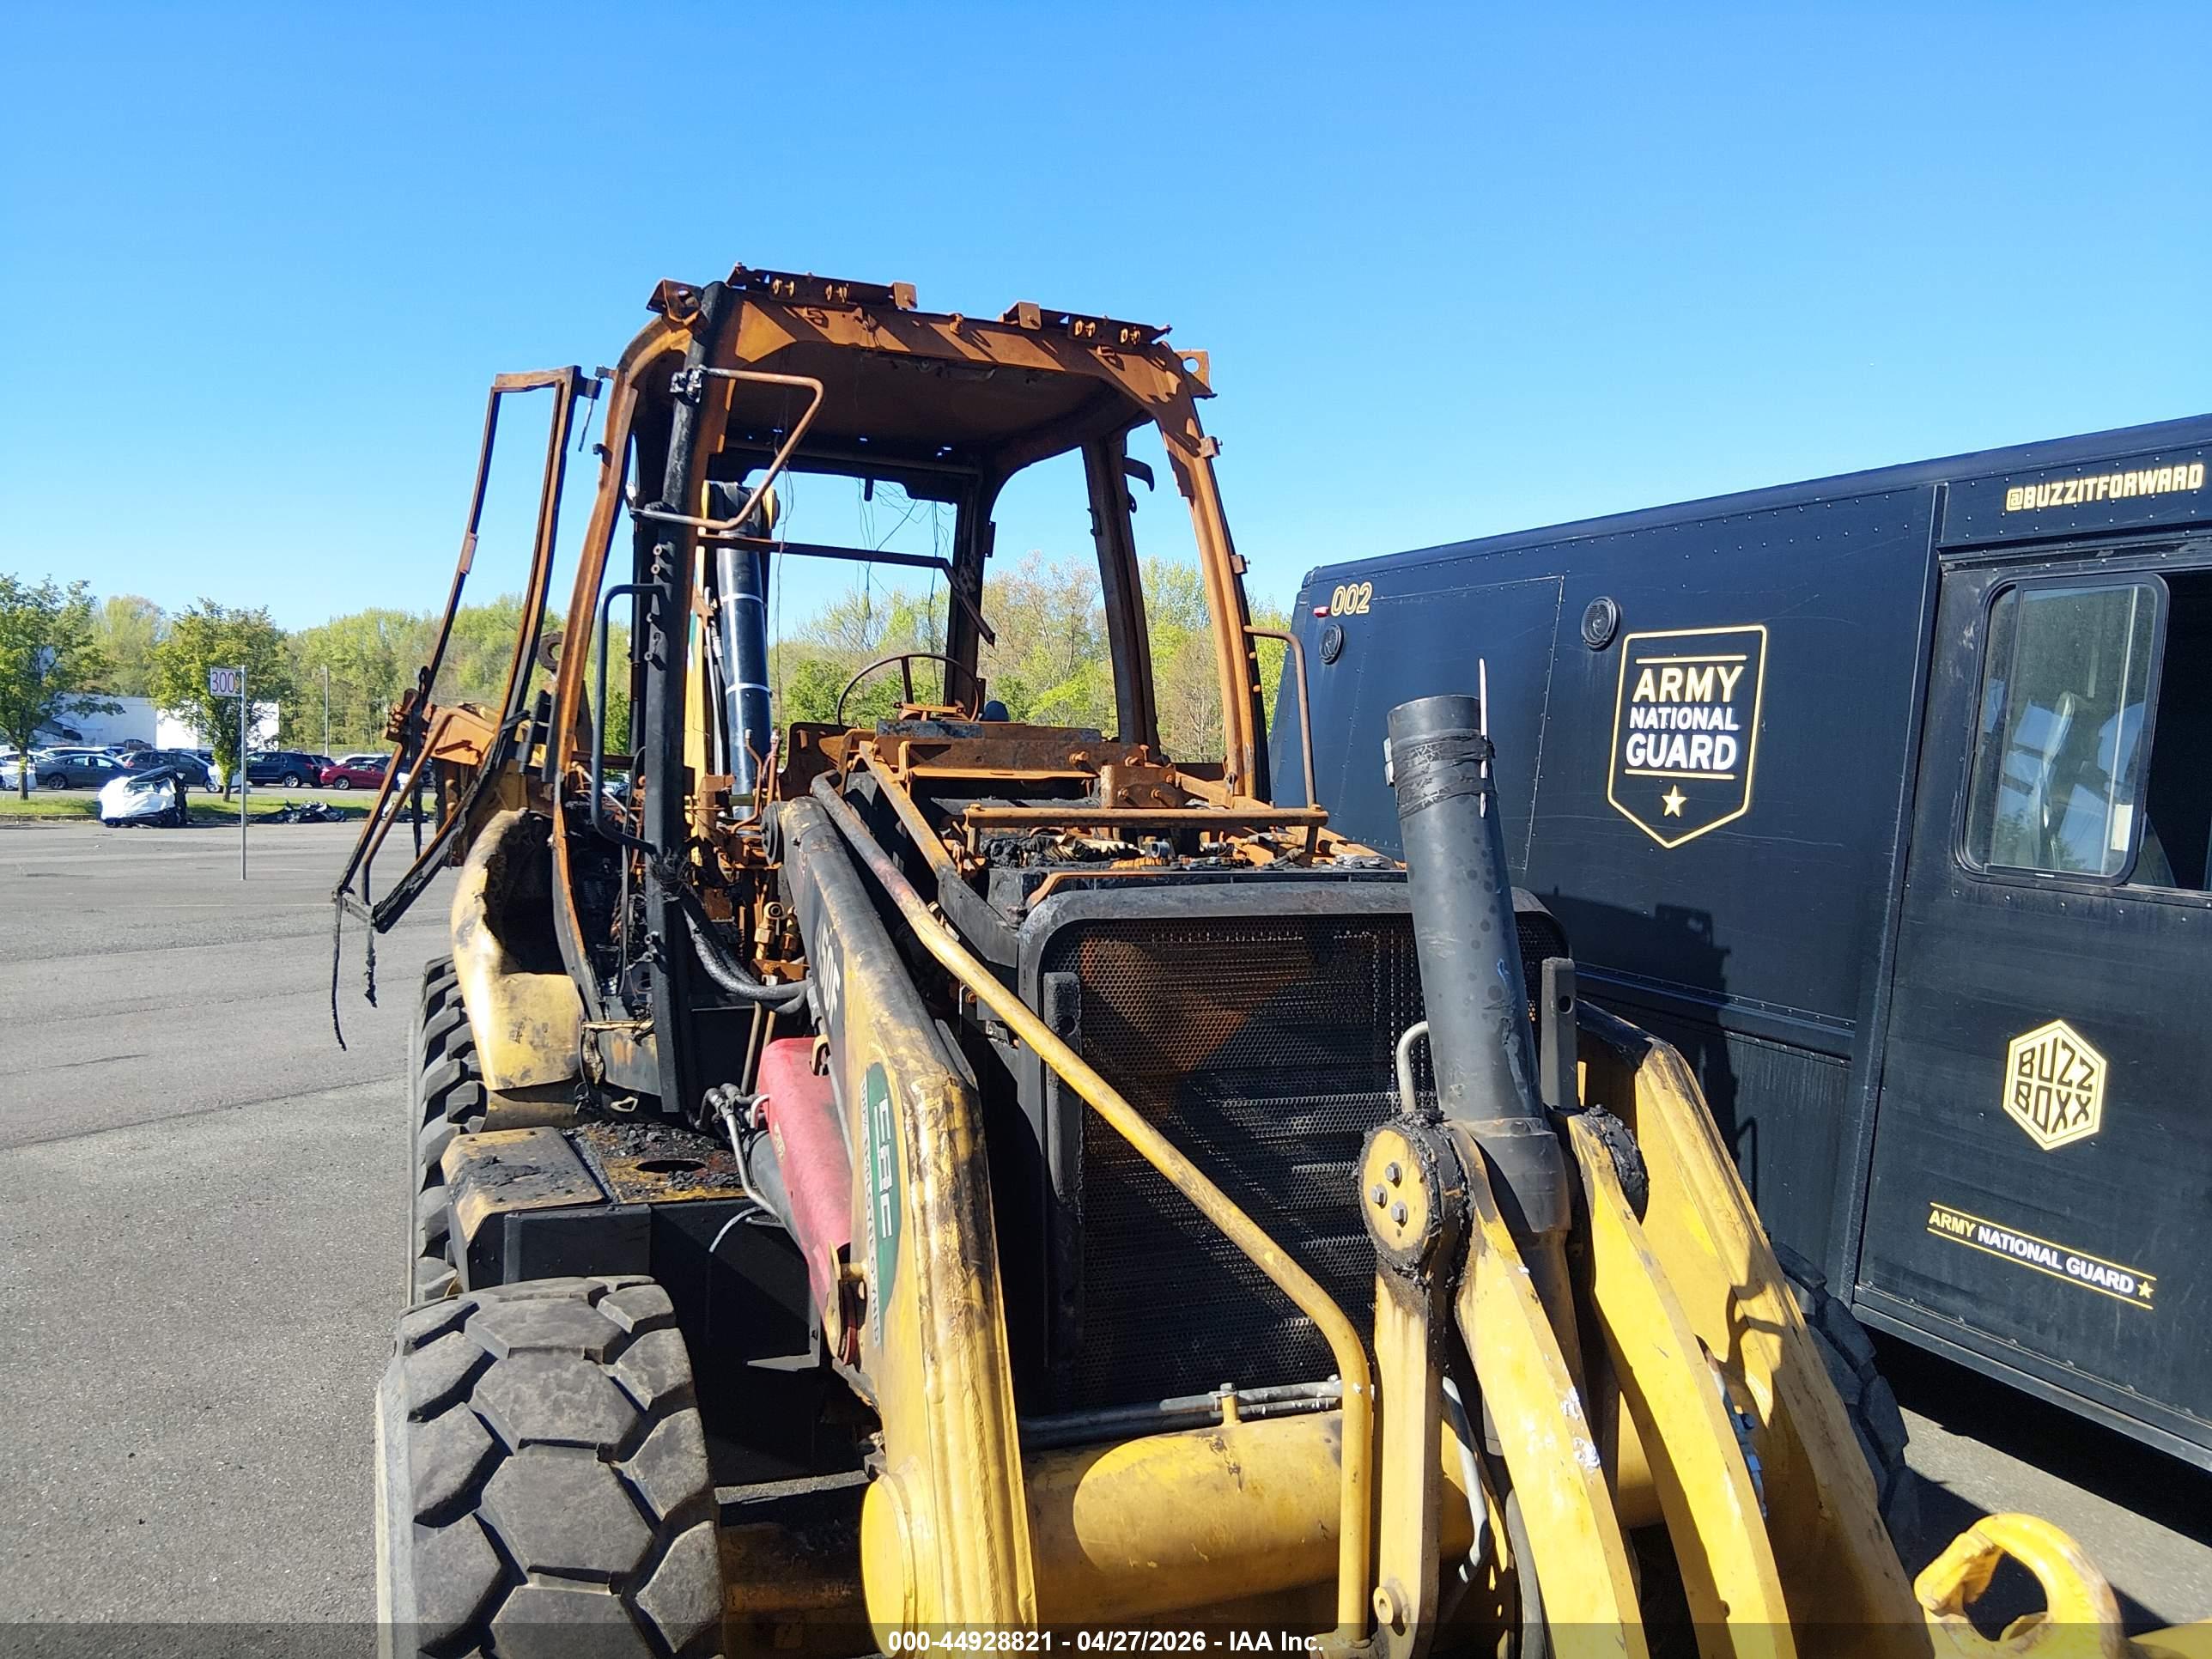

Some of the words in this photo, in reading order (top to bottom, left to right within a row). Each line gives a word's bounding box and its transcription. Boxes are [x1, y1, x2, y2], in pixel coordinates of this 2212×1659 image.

[2006, 464, 2204, 511] @BUZZITFORWARD
[1331, 582, 1372, 617] 002
[212, 672, 235, 692] 300
[1632, 666, 1744, 702] ARMY
[1630, 707, 1740, 731] NATIONAL
[1626, 733, 1737, 770] GUARD
[2018, 1037, 2095, 1092] BUZZ
[2014, 1080, 2092, 1134] BOXX
[1929, 1210, 1976, 1237] ARMY
[1978, 1225, 2063, 1269] NATIONAL
[2066, 1256, 2135, 1293] GUARD
